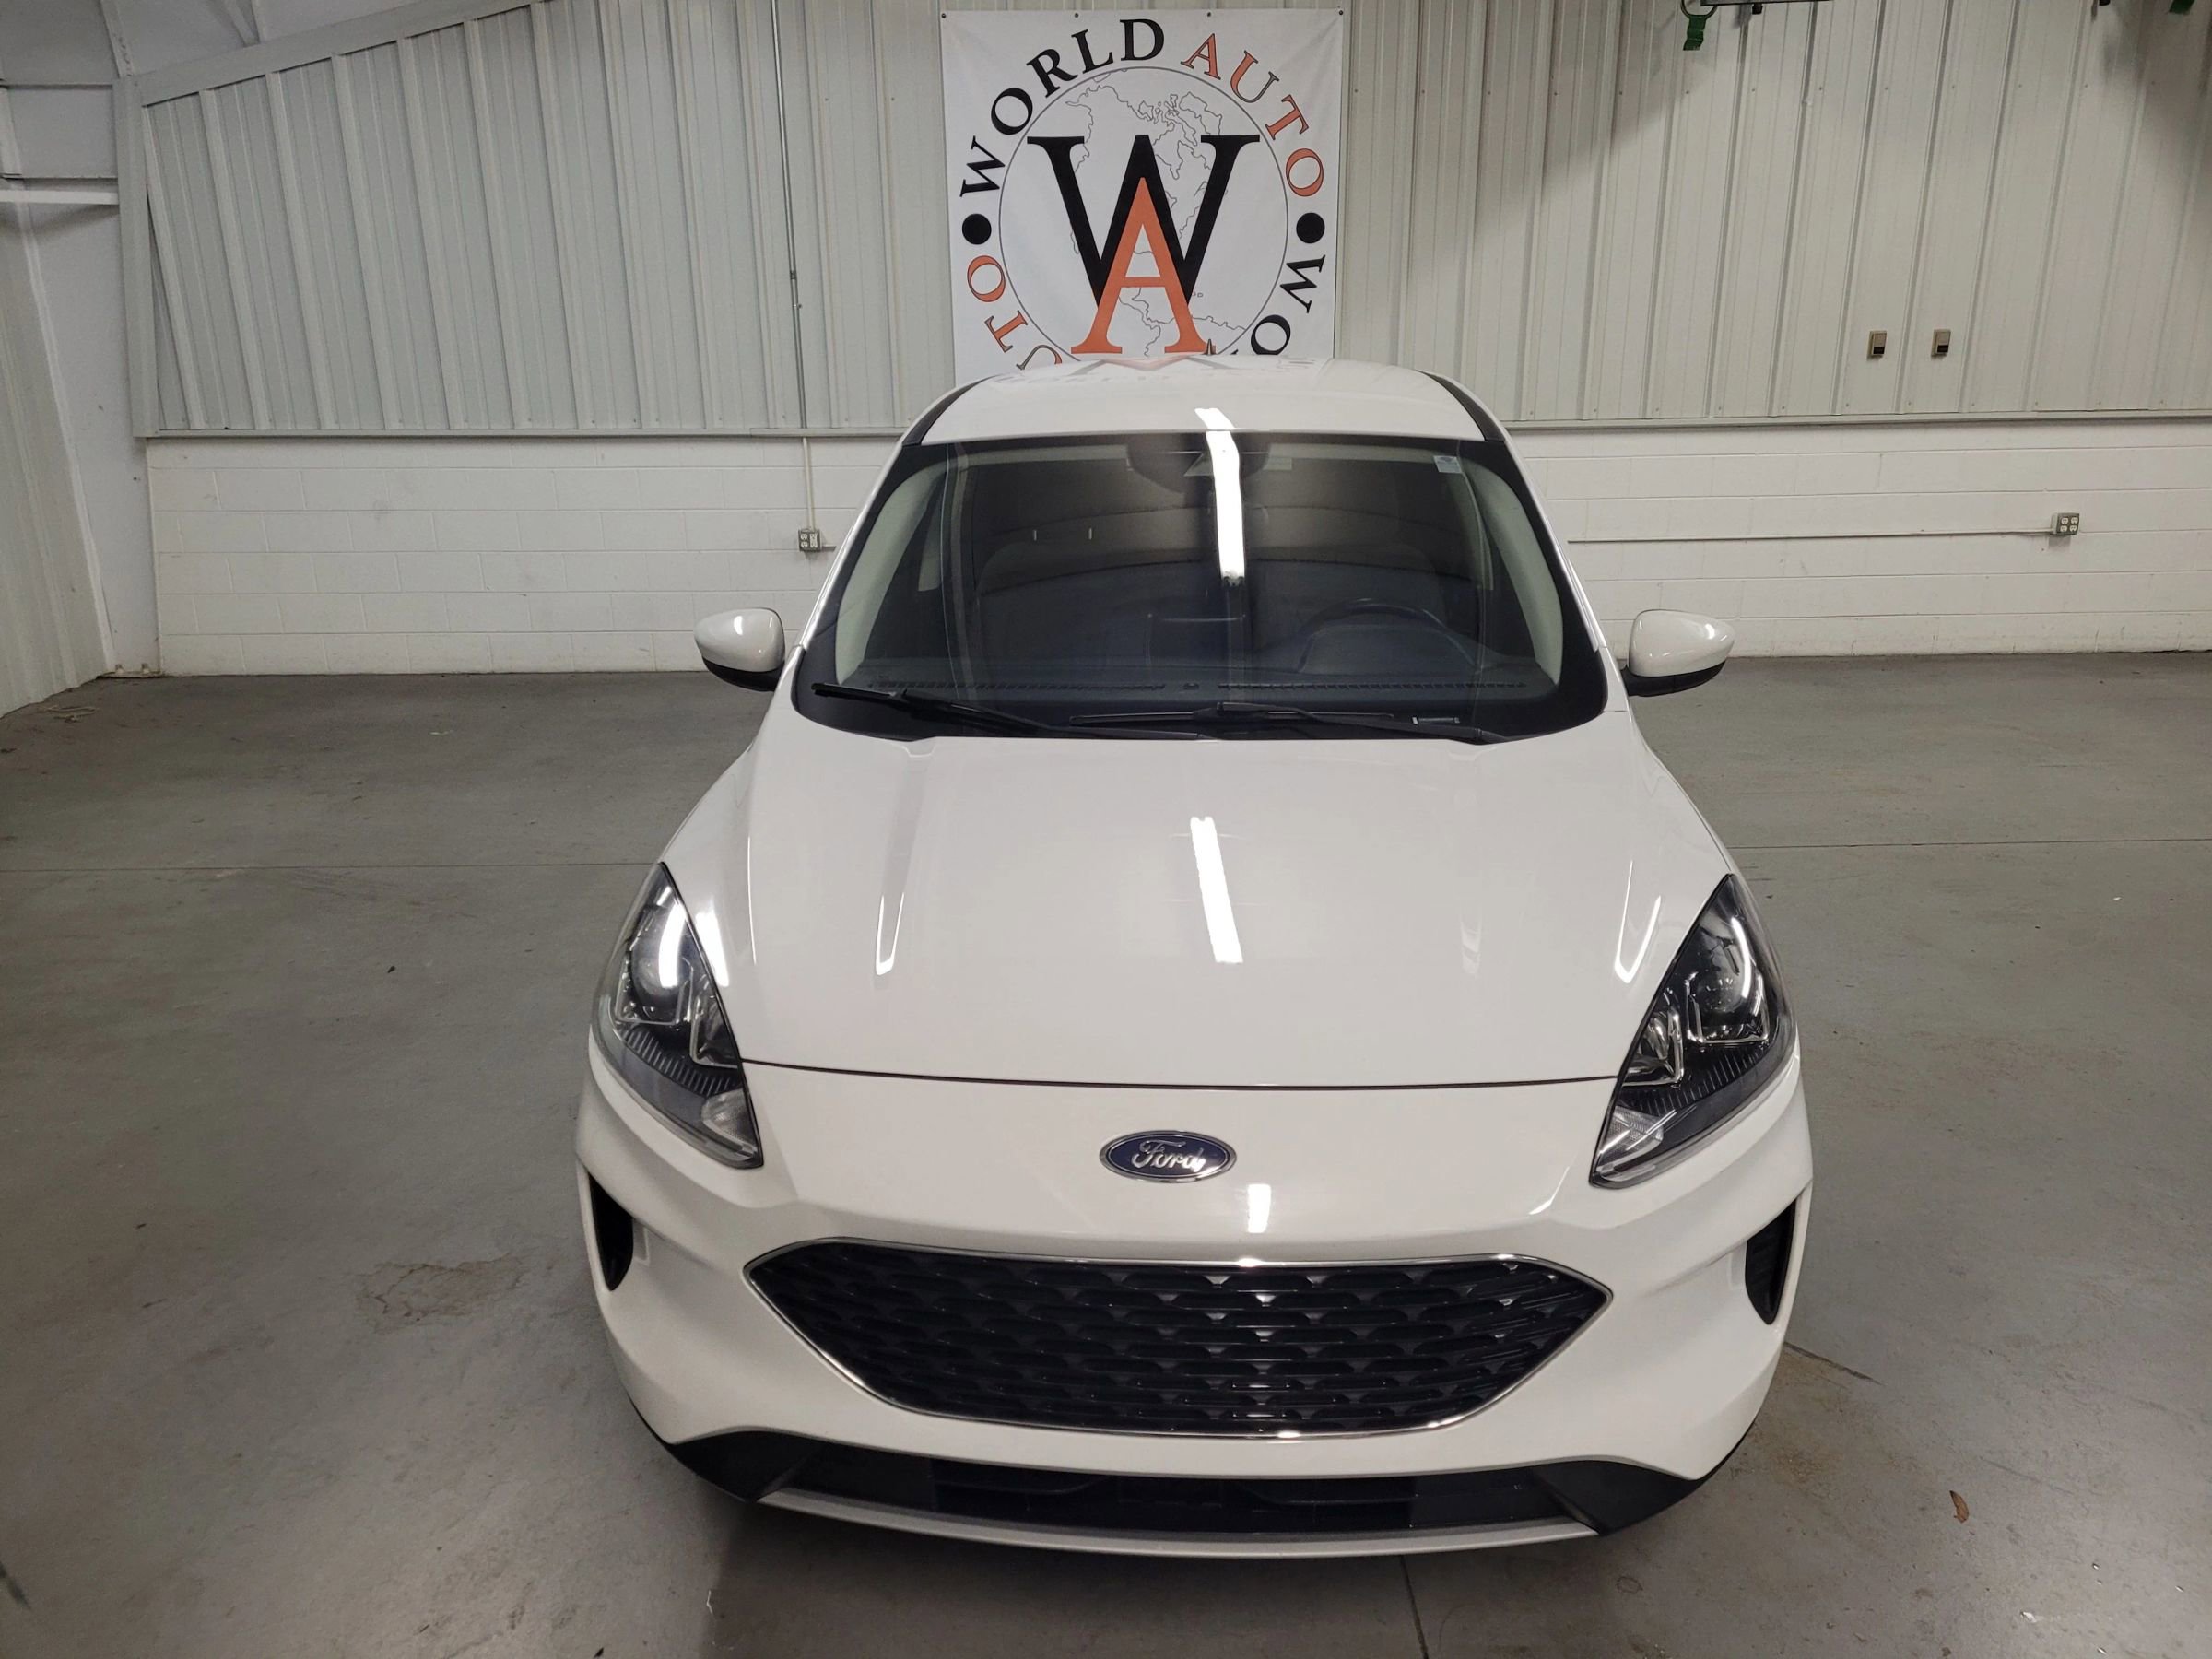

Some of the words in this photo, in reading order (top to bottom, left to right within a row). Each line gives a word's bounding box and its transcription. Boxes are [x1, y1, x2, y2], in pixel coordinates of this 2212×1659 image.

[959, 18, 1165, 198] WORLD
[1181, 33, 1324, 197] AUTO
[966, 255, 1063, 371] UTO
[1231, 254, 1326, 356] WO
[1131, 1139, 1206, 1173] Ford
